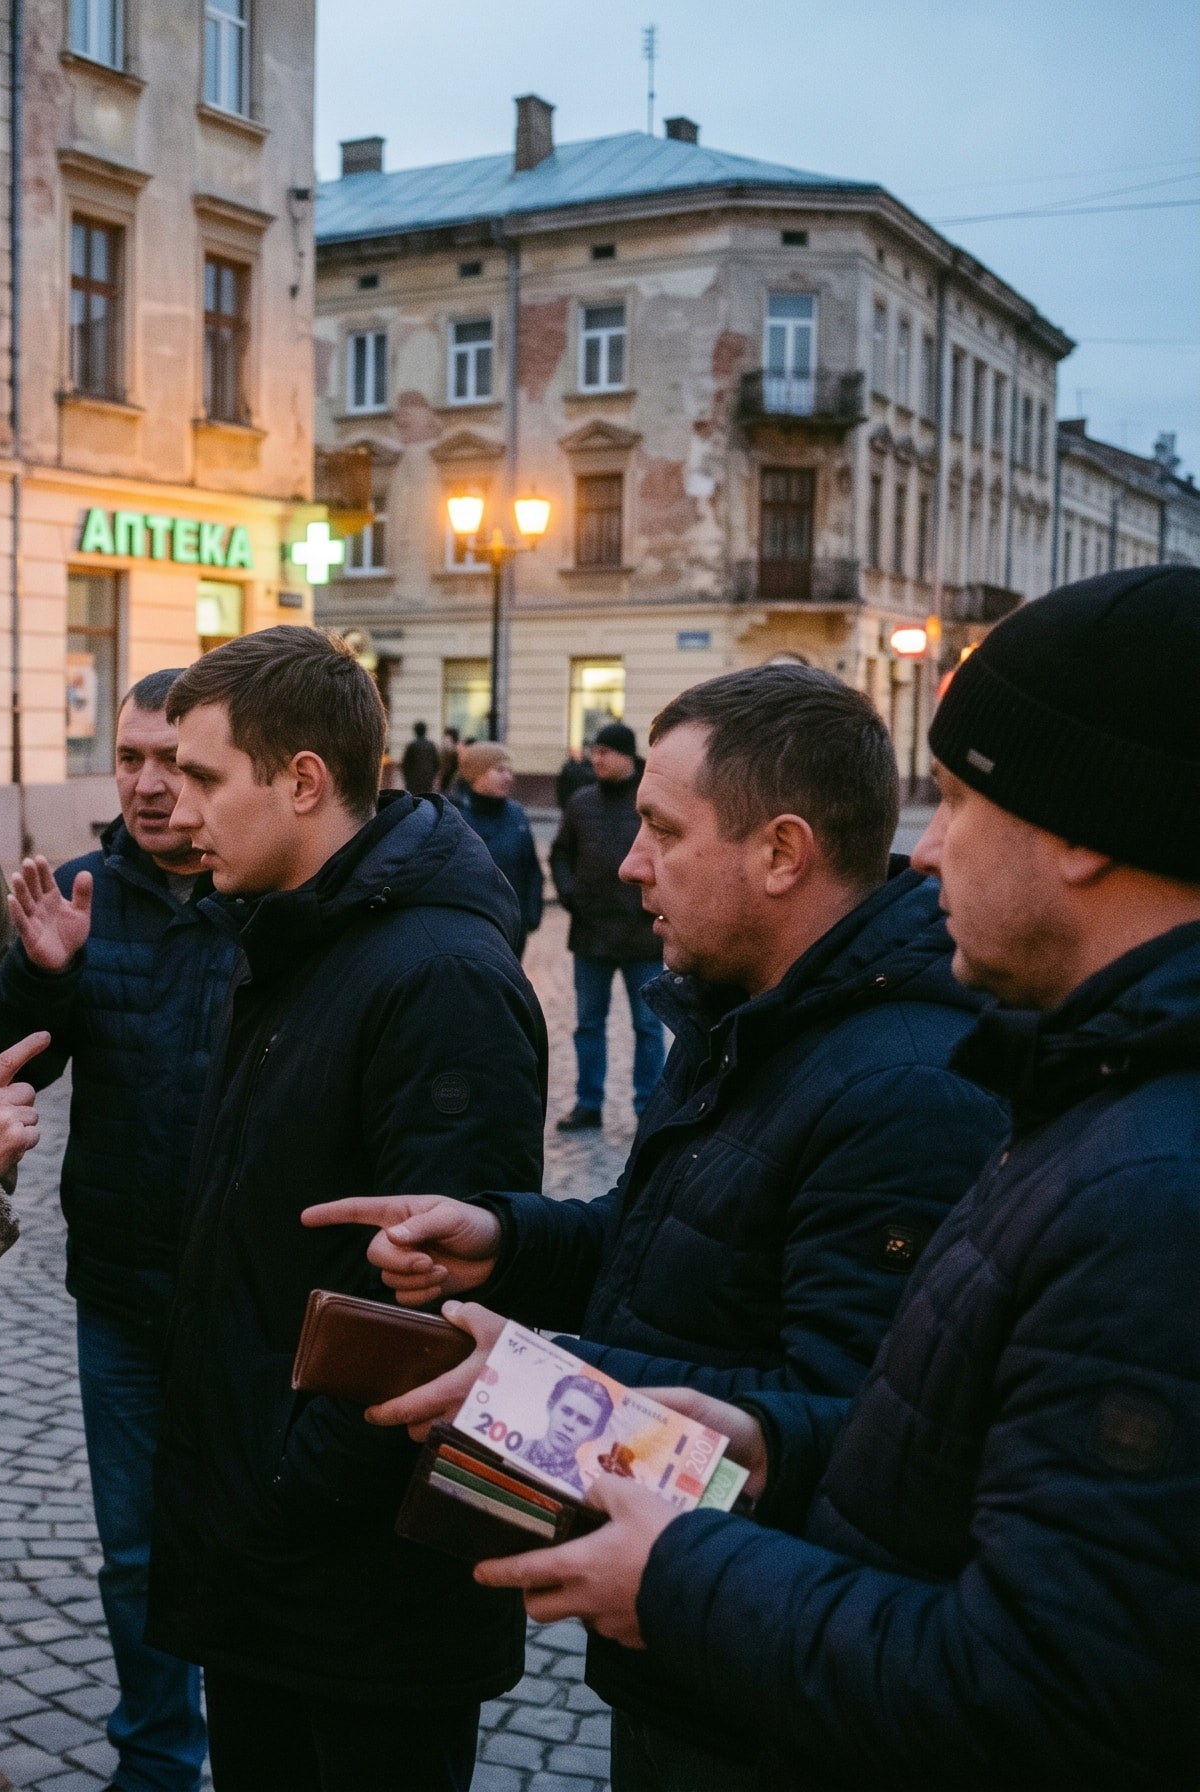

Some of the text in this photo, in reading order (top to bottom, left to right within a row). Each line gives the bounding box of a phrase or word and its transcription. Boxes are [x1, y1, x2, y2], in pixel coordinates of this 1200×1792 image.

[80, 507, 253, 569] АПТЕКА
[473, 1412, 523, 1451] 200
[685, 1439, 713, 1474] 200
